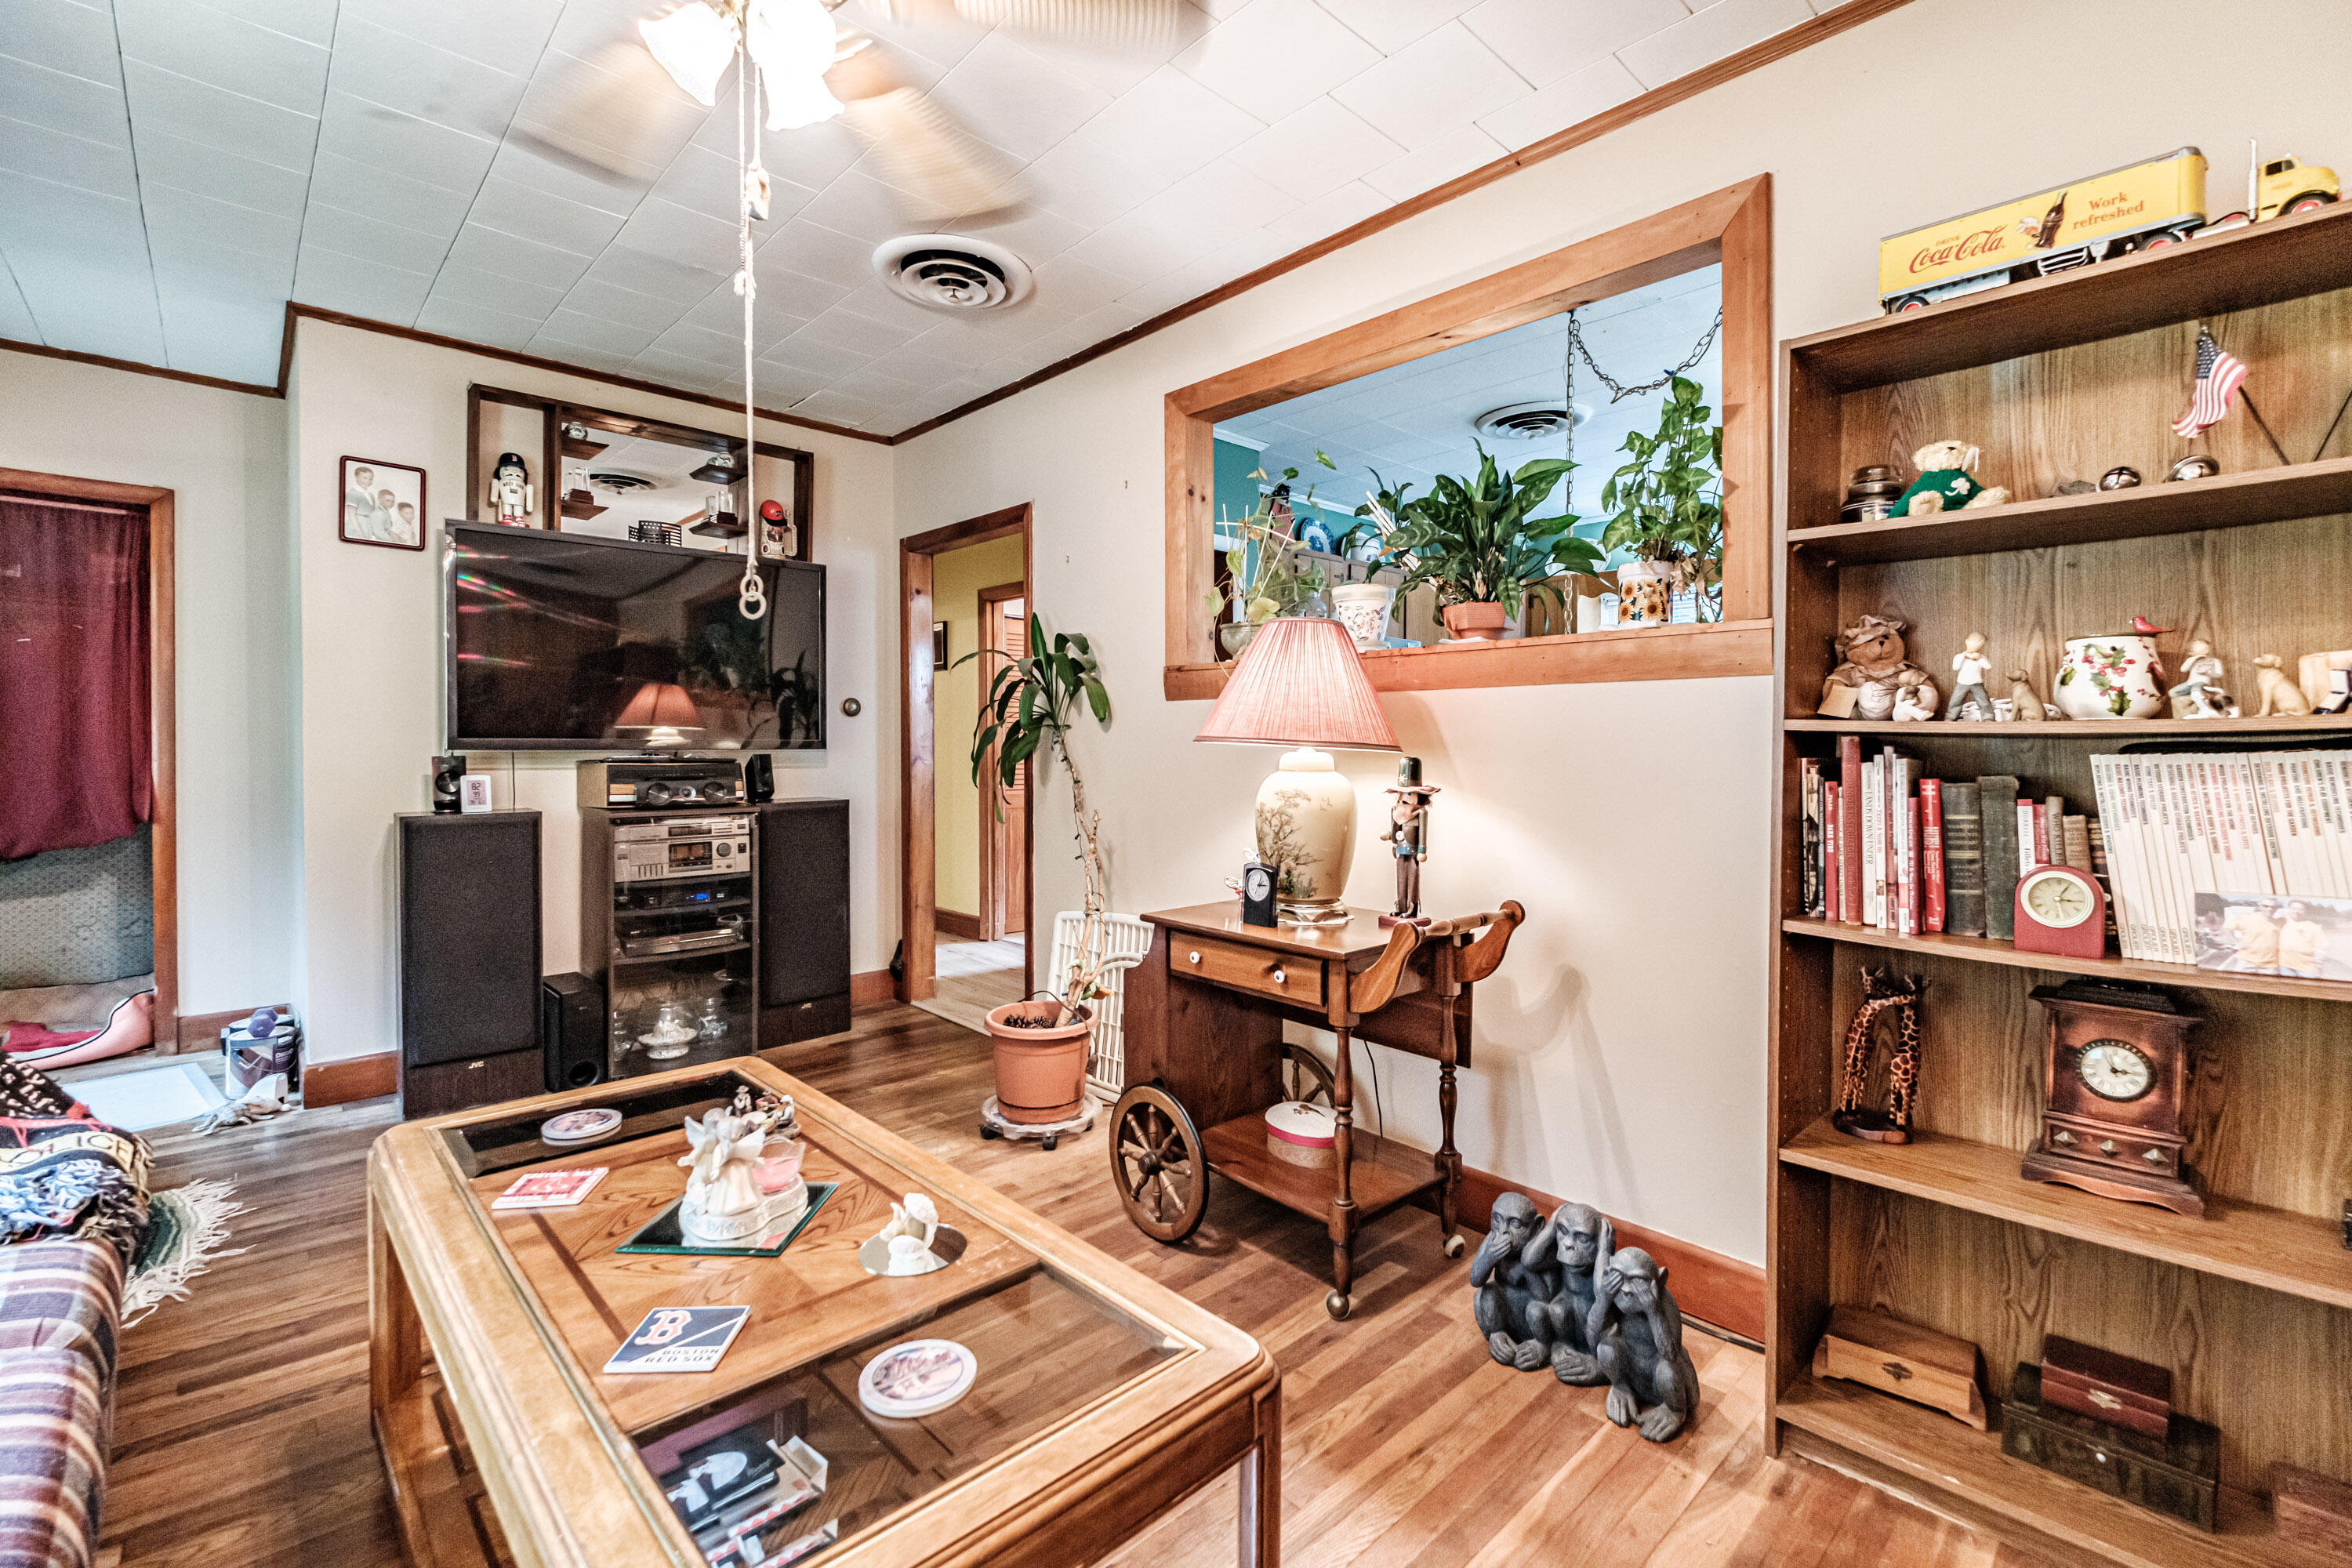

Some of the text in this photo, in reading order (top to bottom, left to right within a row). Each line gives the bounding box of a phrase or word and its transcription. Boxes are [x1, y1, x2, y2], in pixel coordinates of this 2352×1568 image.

[2089, 192, 2129, 211] Work
[2073, 200, 2144, 230] refreshed
[1909, 224, 2008, 274] Coca-Cola
[1936, 235, 1961, 246] DRINK
[1865, 791, 1874, 813] LANDS
[1865, 815, 1874, 839] DOWN
[1924, 826, 1940, 848] NUTS!
[1865, 840, 1874, 865] UNDER
[2055, 834, 2063, 865] KILLED
[468, 1061, 485, 1069] JVC
[633, 1309, 692, 1346] B
